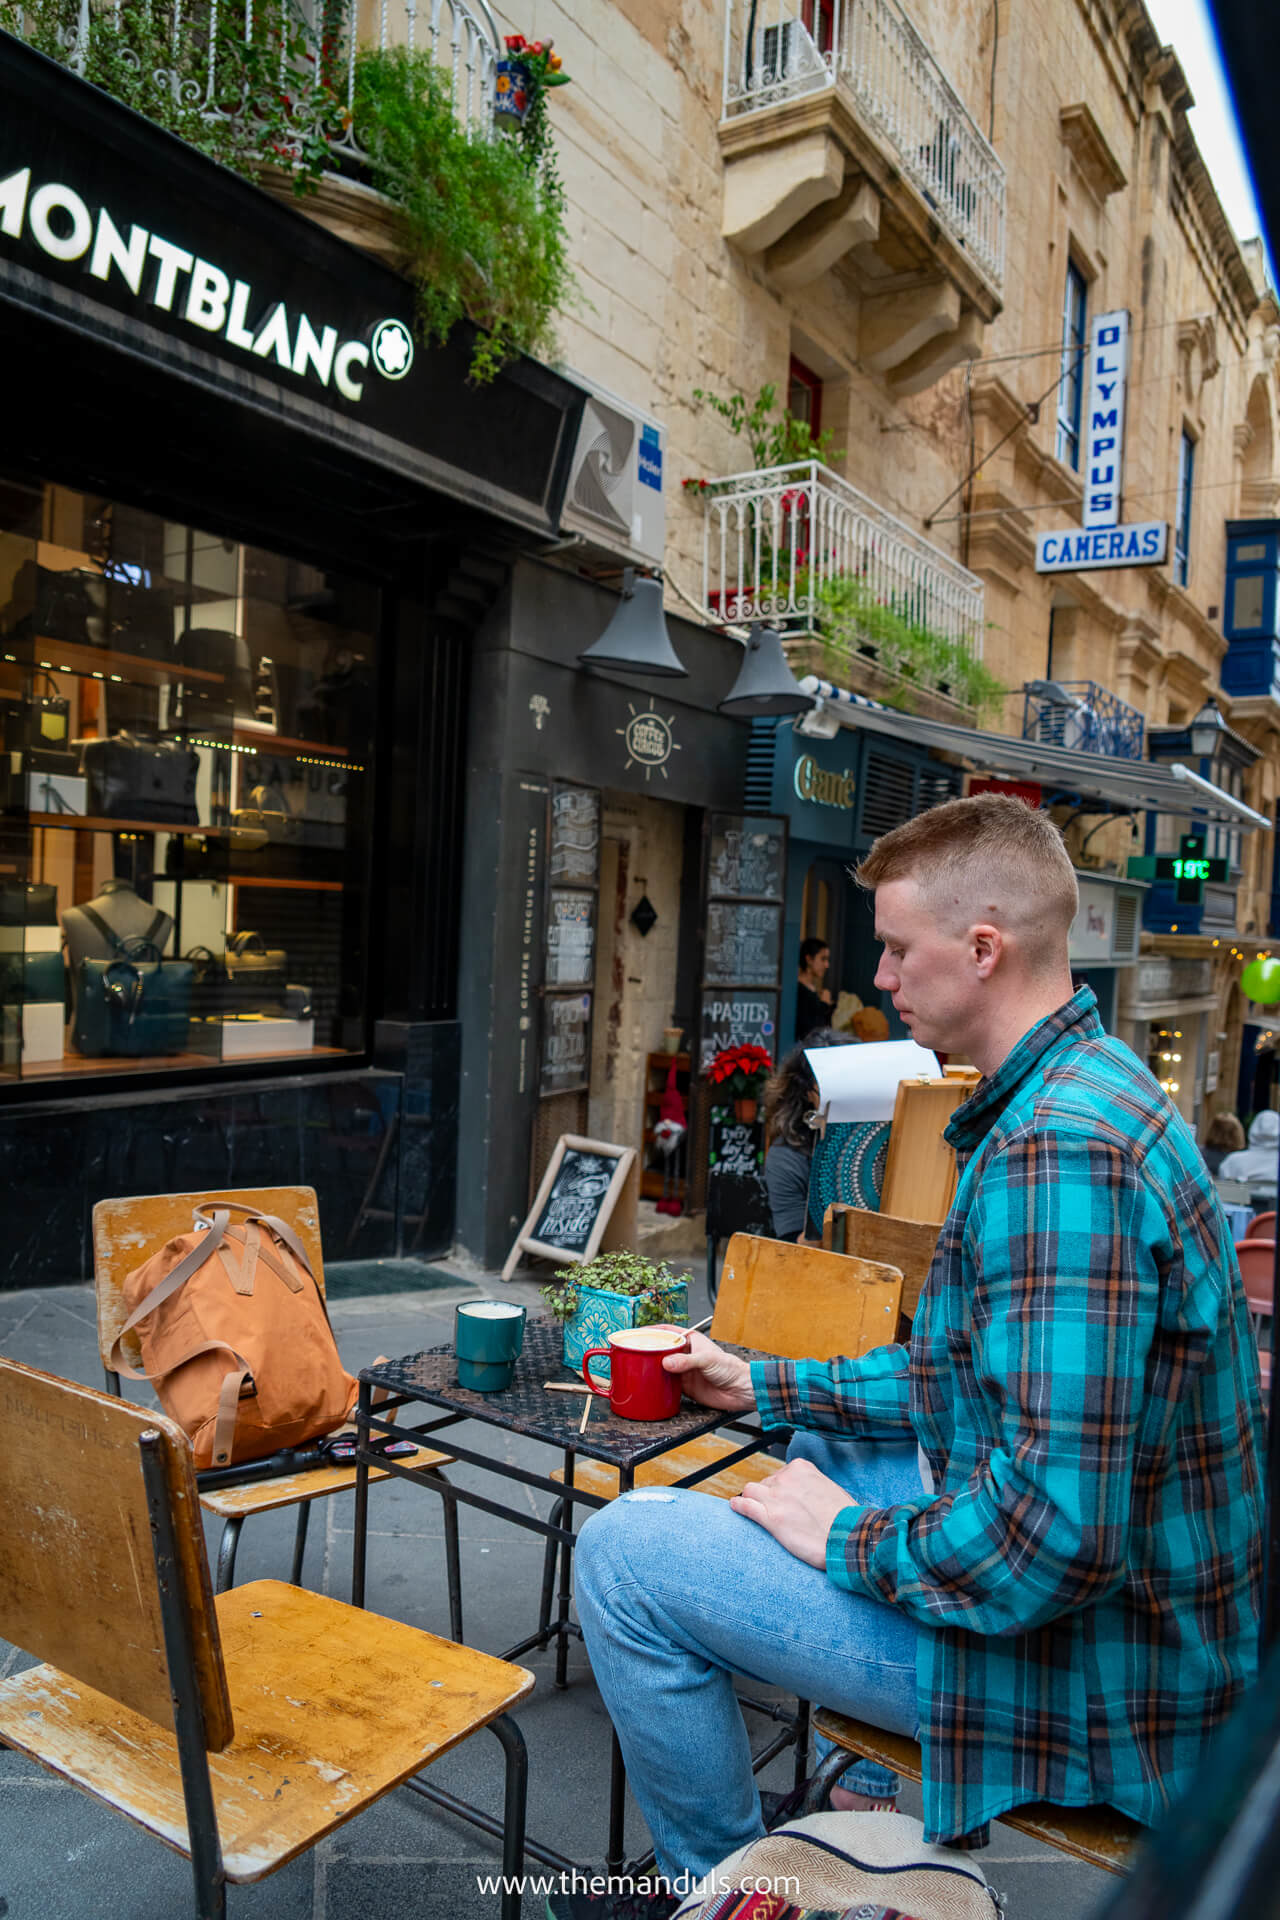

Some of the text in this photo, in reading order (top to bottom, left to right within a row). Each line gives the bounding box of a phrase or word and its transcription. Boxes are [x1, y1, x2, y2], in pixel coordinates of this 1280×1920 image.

[1089, 326, 1121, 513] OLYMPUS
[1042, 528, 1160, 564] CAMERAS
[520, 828, 537, 1010] COFFEE CIRCUS LISBOA
